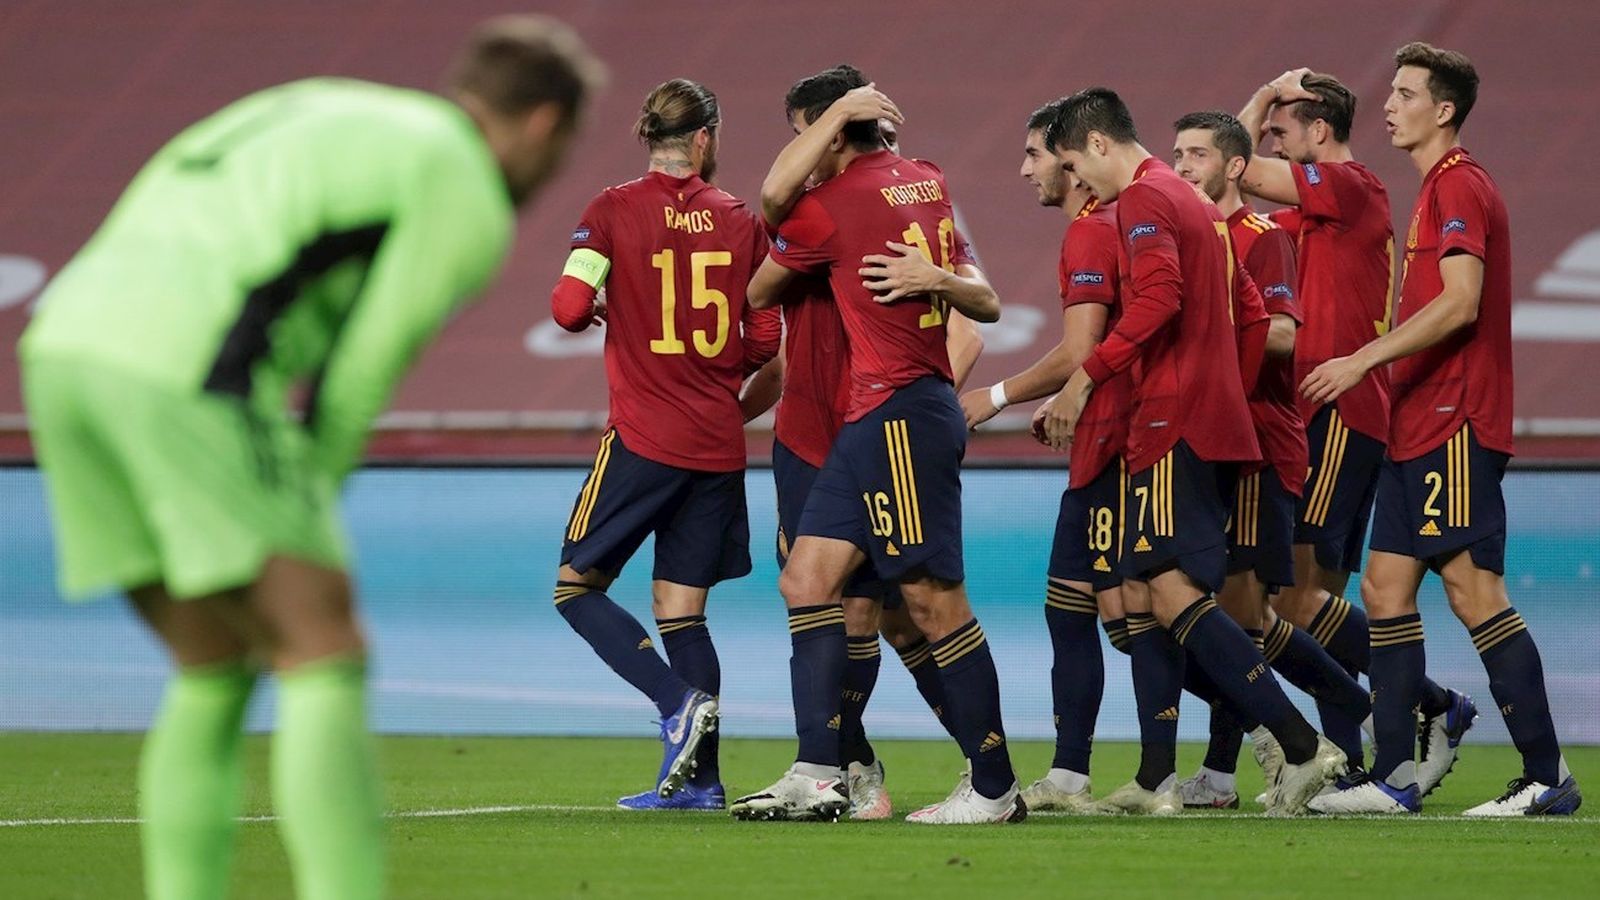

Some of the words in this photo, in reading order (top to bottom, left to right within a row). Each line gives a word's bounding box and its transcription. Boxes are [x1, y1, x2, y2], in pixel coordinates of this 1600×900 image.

[880, 180, 943, 207] RODRIGO
[664, 206, 714, 234] RAMOS
[1075, 274, 1103, 282] RESPECT
[650, 249, 732, 358] 15
[863, 491, 893, 537] 16
[1135, 486, 1148, 532] 7
[1423, 471, 1442, 516] 2
[1088, 507, 1113, 551] 18
